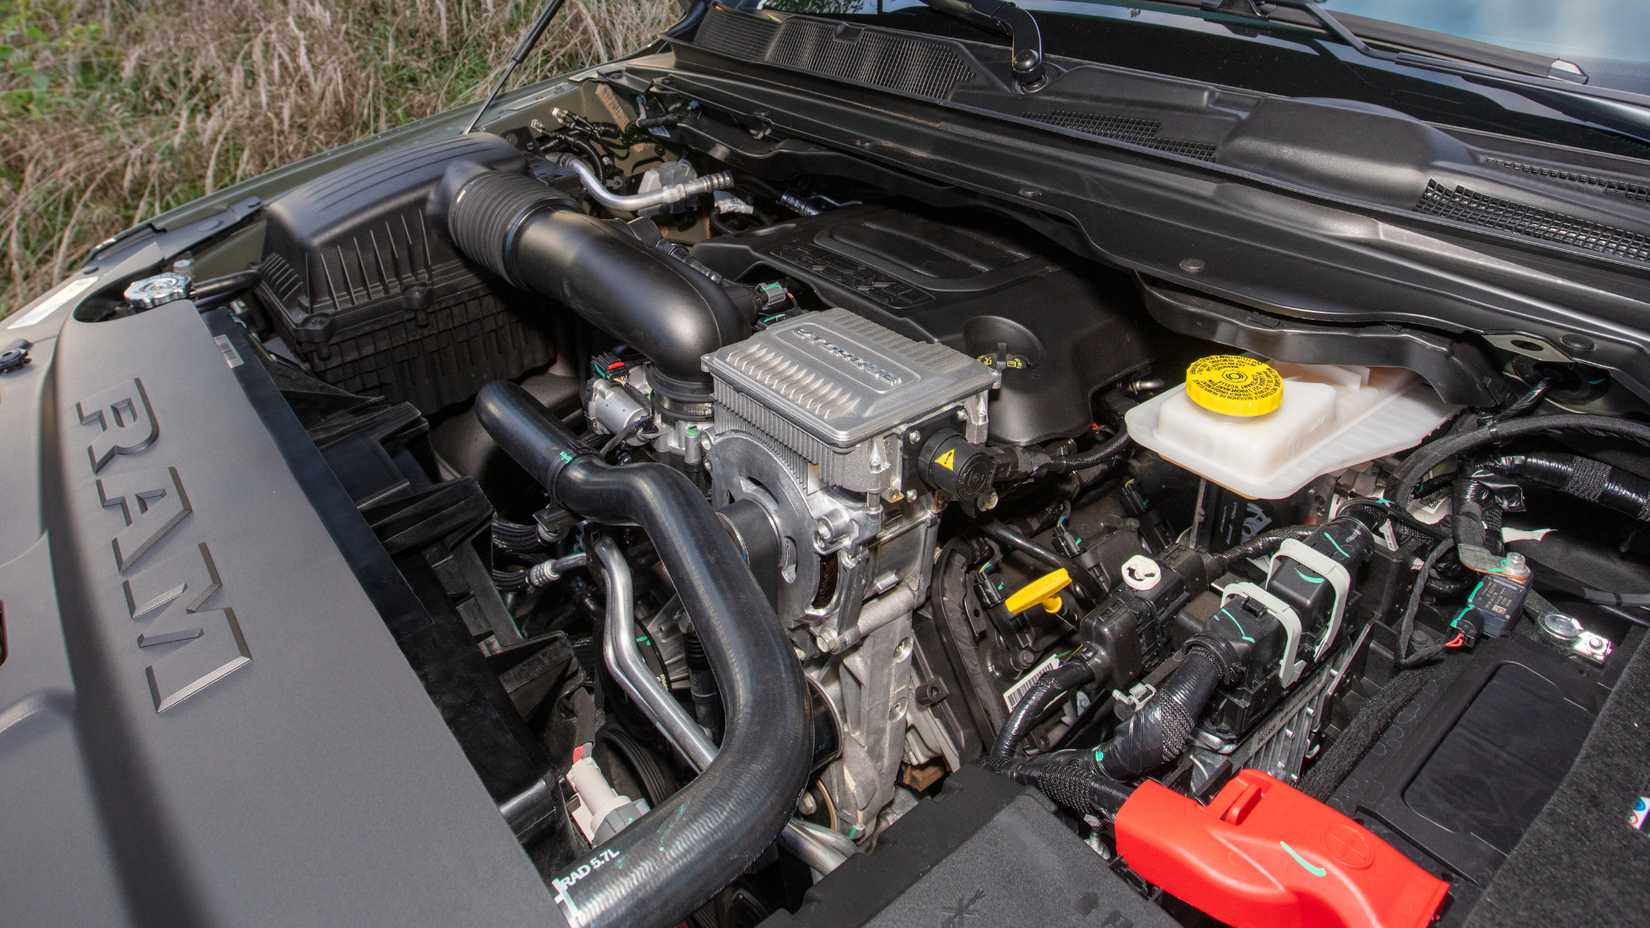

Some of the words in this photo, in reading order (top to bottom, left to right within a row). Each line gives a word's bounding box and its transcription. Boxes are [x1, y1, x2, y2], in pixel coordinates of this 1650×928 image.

[75, 376, 253, 713] RAM
[560, 864, 591, 890] RAD
[590, 849, 620, 869] 5.7L
